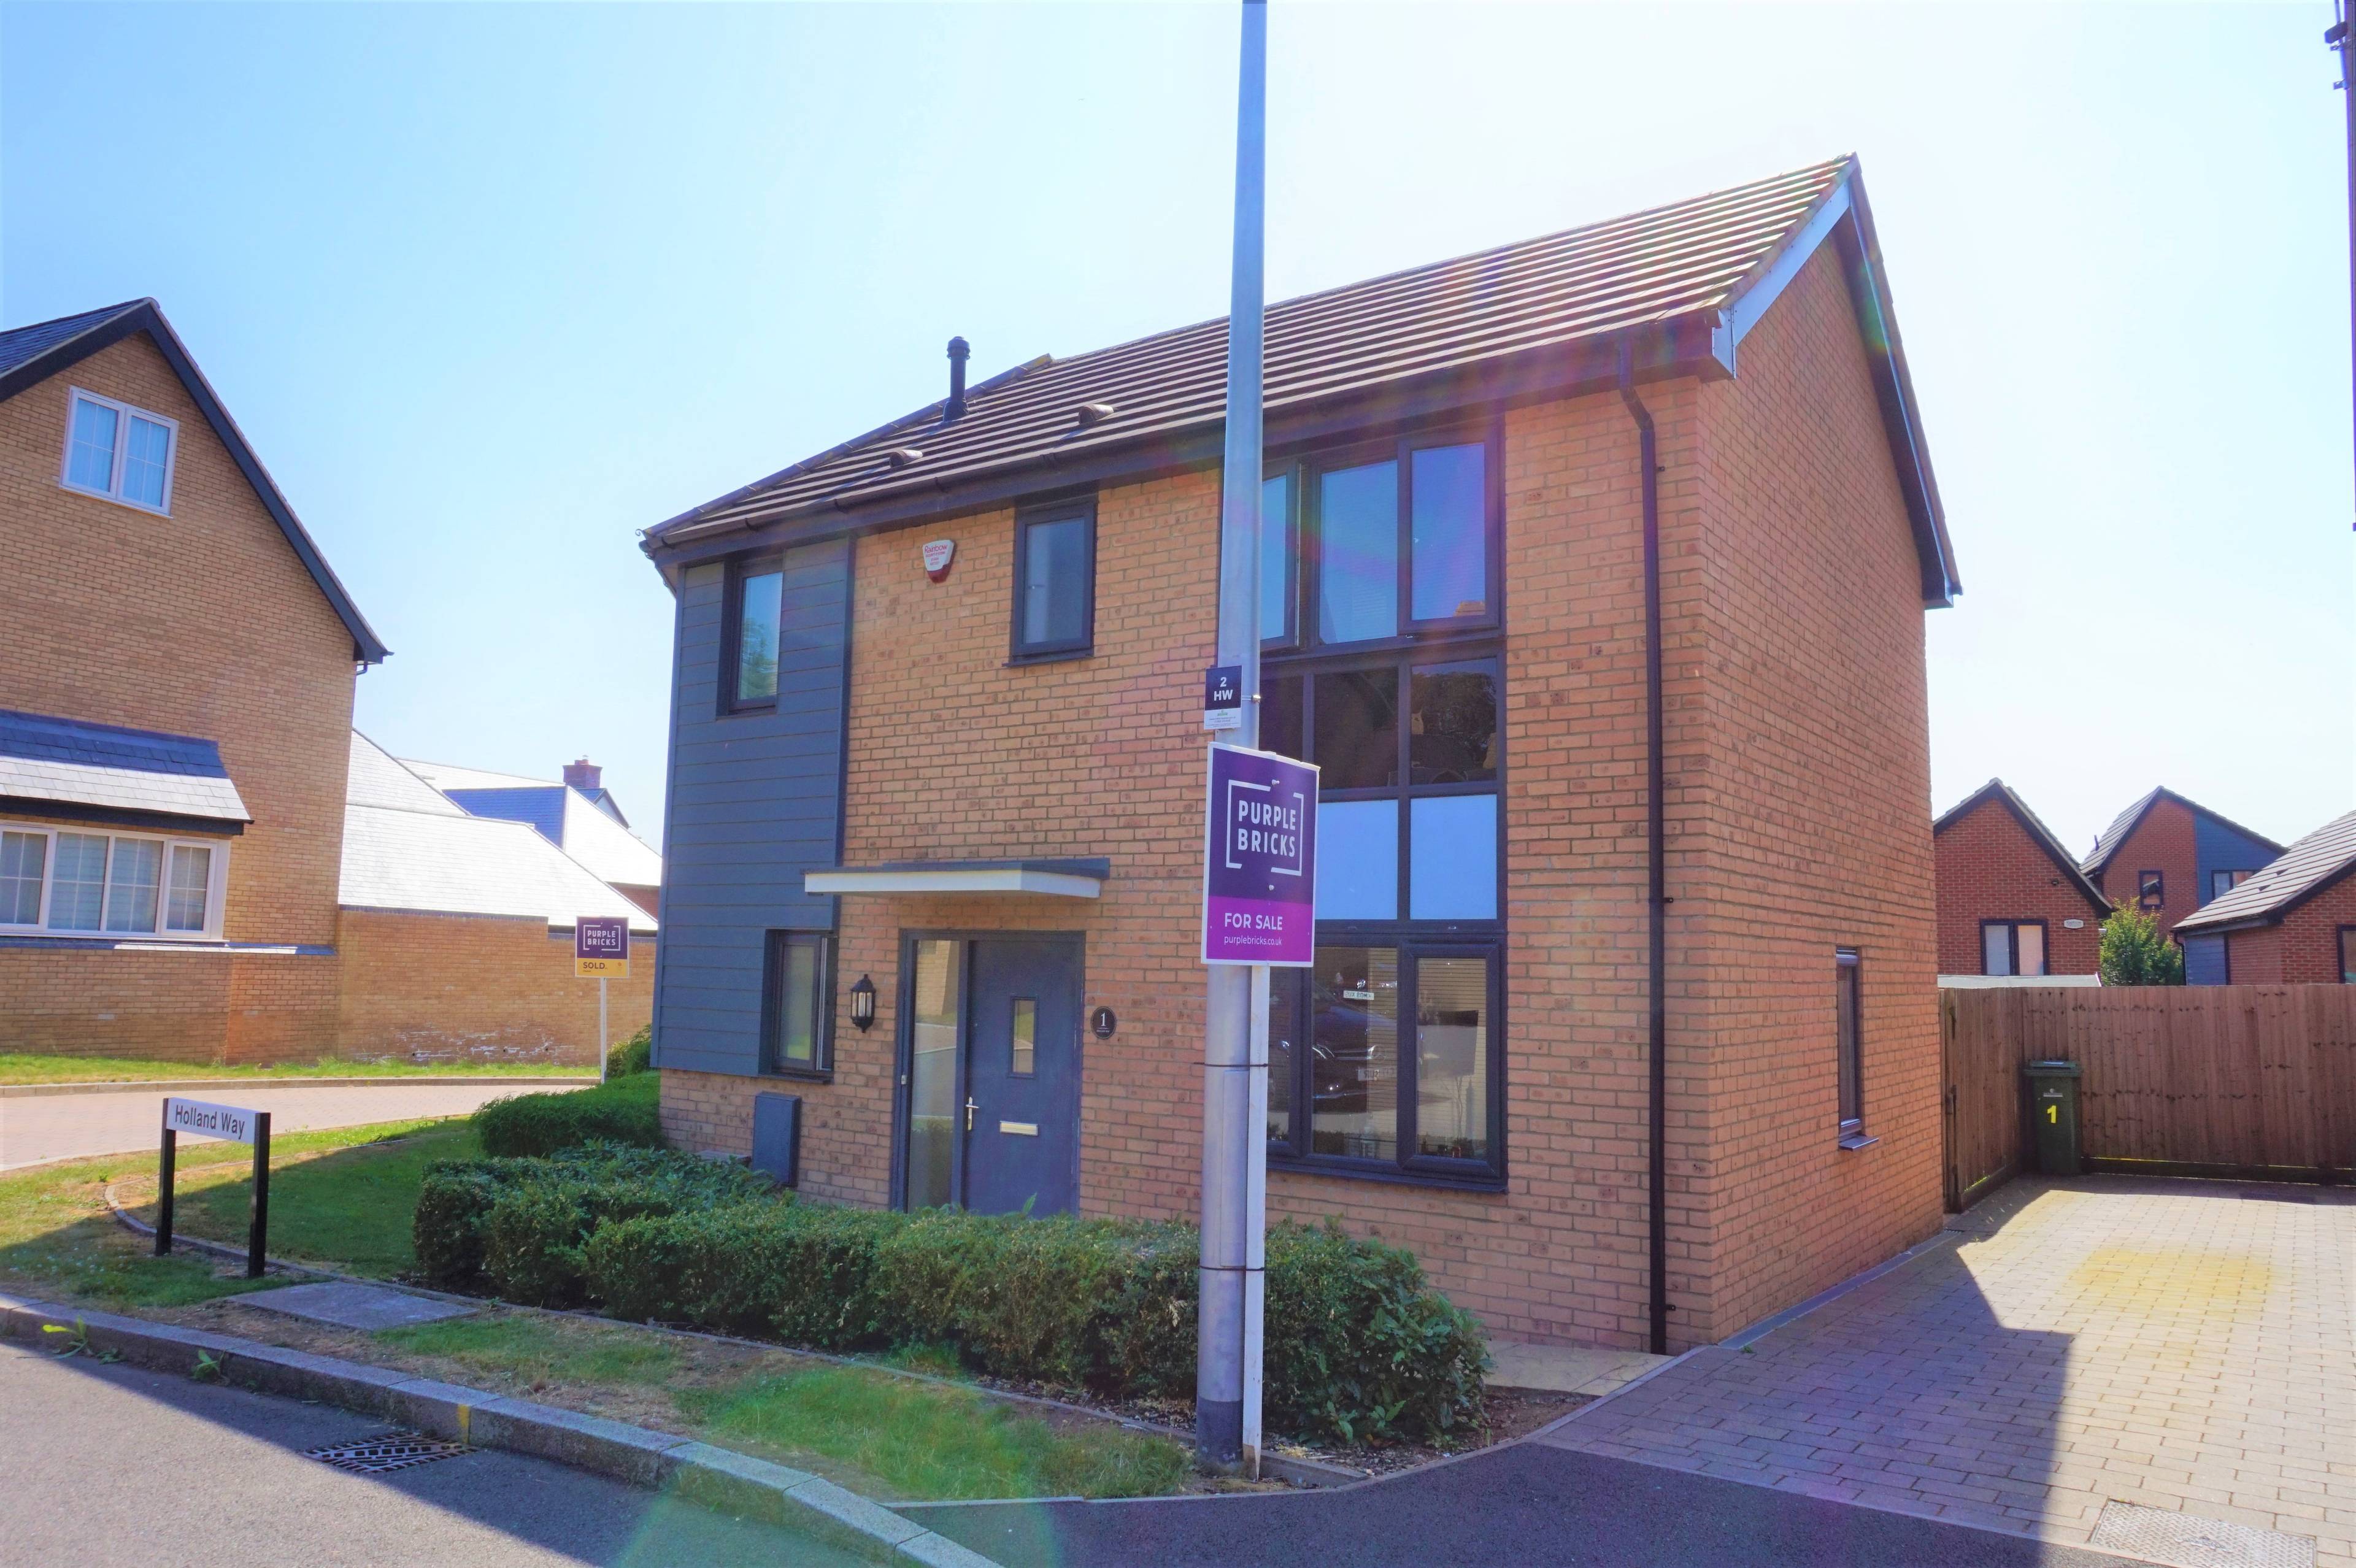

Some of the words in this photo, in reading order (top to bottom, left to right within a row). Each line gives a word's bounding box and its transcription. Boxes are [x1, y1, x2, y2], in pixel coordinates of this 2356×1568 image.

[925, 544, 948, 553] Rainbow
[1220, 677, 1226, 687] 2
[1214, 690, 1233, 701] HW
[1238, 800, 1296, 831] PURPLE
[1238, 828, 1296, 857] BRICKS
[1224, 913, 1251, 929] FOR
[1255, 915, 1283, 931] SALE
[1224, 934, 1282, 948] purplebricks.co.uk
[1101, 1012, 1106, 1026] 1
[175, 1104, 217, 1130] Holland
[221, 1112, 245, 1140] Way
[2047, 1105, 2057, 1124] 1
